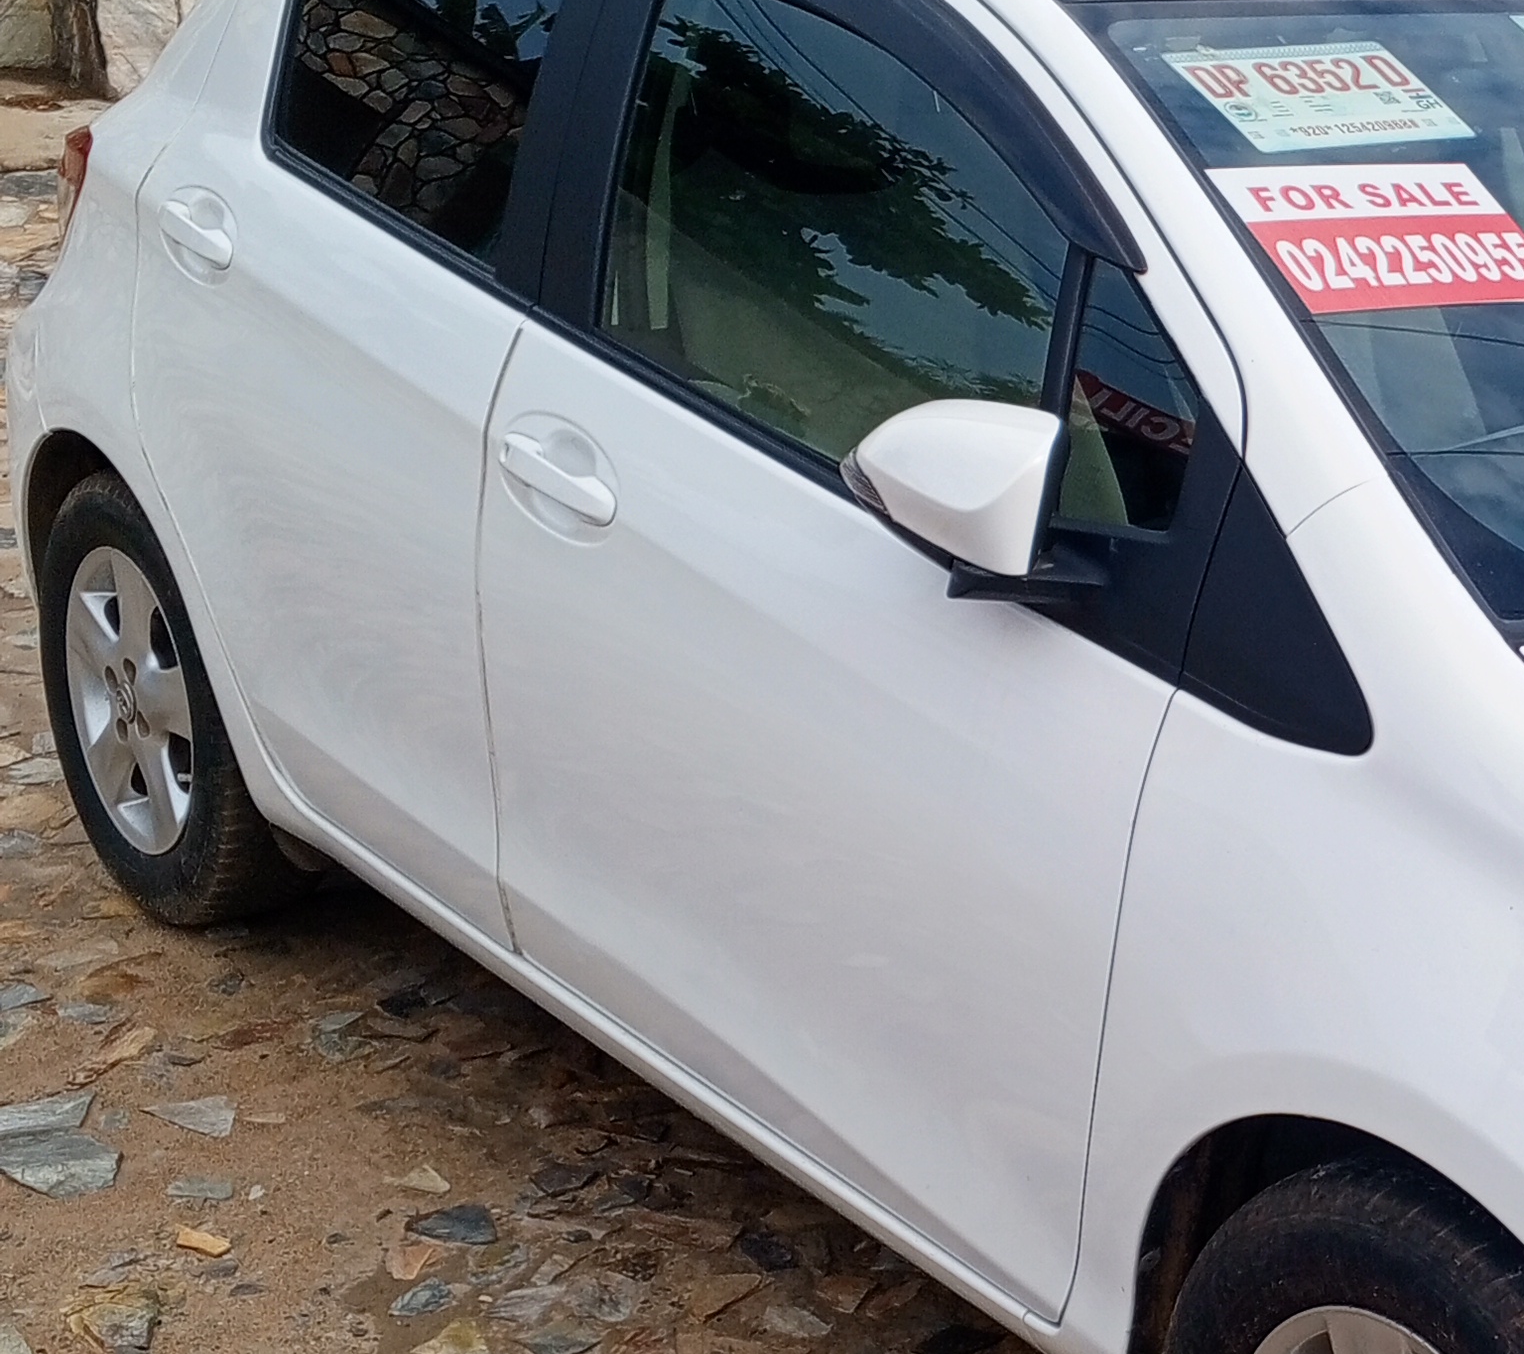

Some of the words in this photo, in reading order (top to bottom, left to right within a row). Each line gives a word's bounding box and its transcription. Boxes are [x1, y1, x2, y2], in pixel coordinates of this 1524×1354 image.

[1182, 63, 1251, 100] DP
[1252, 57, 1380, 97] 6352
[1360, 54, 1411, 89] D
[1417, 99, 1444, 111] GH
[1246, 184, 1353, 213] FOR
[1359, 180, 1481, 209] SALE
